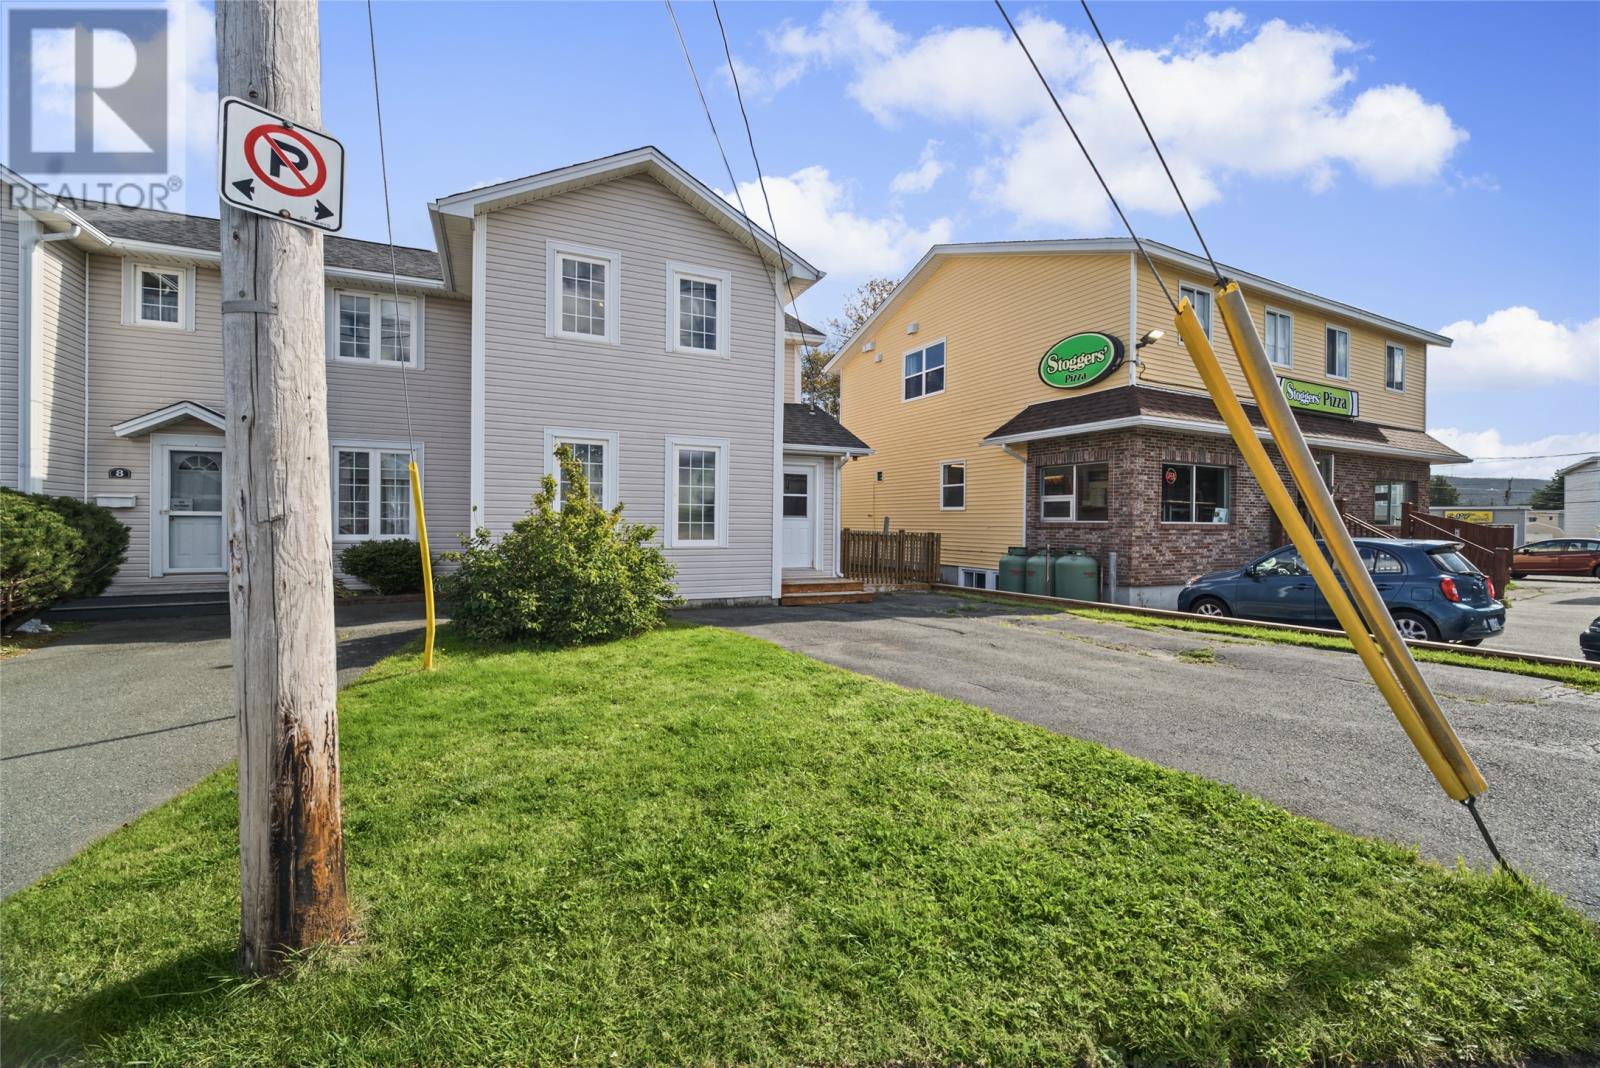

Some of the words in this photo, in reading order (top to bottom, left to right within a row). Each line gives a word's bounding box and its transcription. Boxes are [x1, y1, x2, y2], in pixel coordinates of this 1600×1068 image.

[269, 138, 309, 178] P
[1046, 345, 1108, 374] Stoggers'
[1064, 372, 1088, 383] Pizza
[1323, 391, 1347, 409] Pizza
[115, 469, 124, 478] 8
